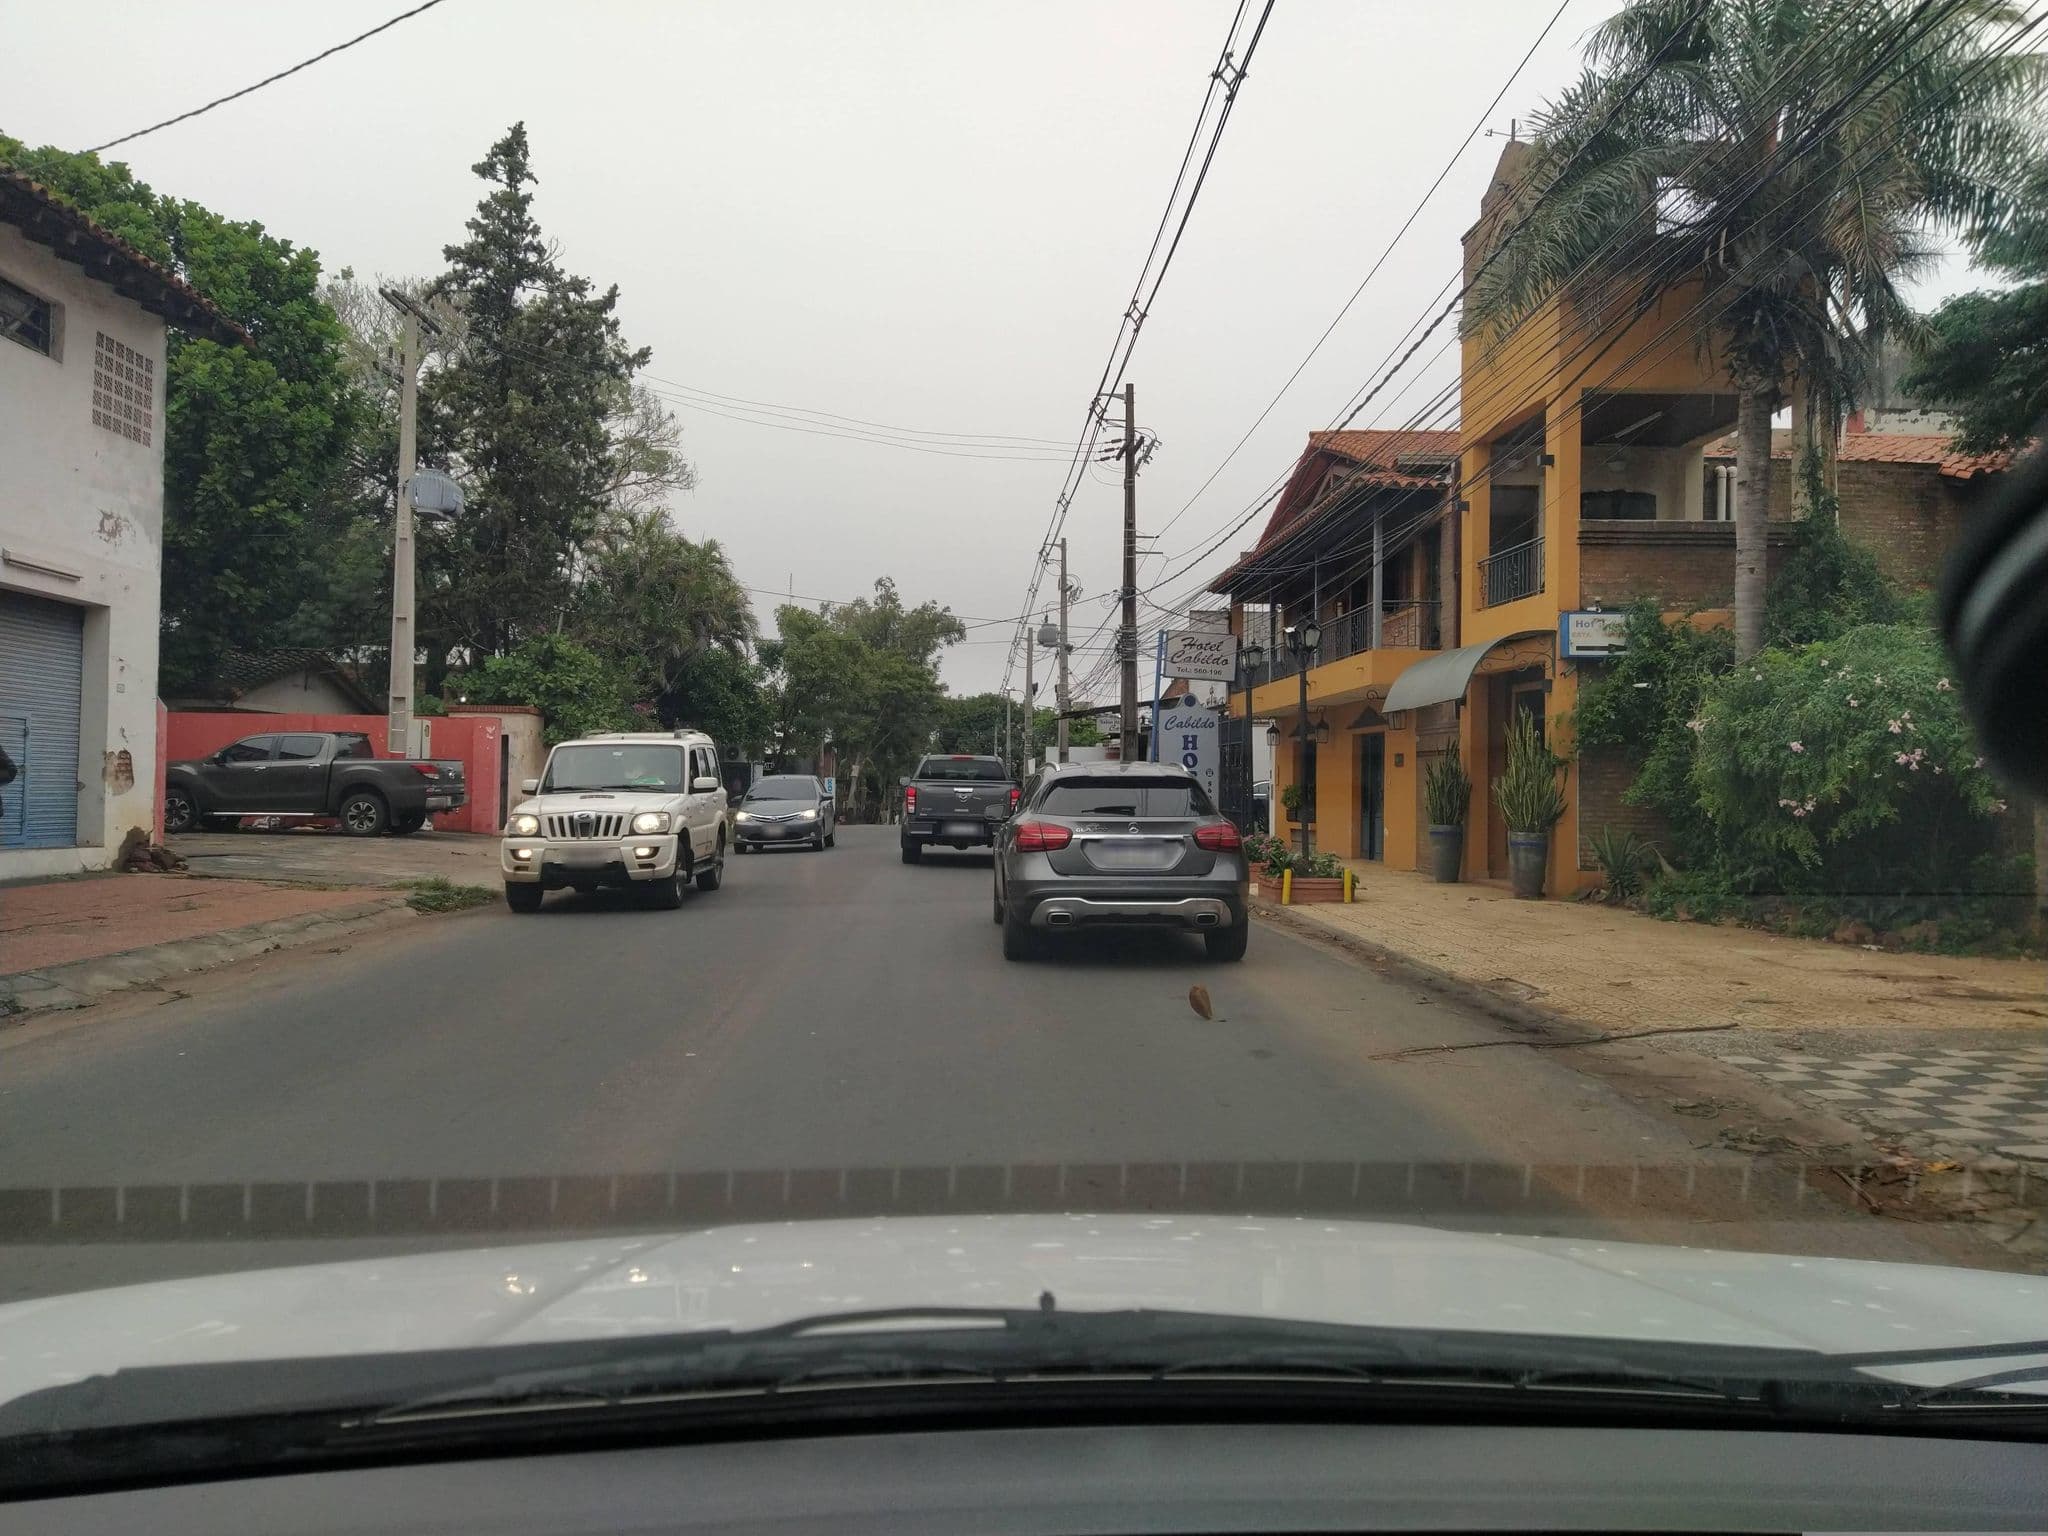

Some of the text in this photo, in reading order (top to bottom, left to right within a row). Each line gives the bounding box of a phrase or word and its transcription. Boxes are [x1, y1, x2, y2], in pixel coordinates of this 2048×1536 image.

[1180, 636, 1224, 650] Hotel
[1170, 649, 1229, 667] Cabildo
[1164, 714, 1215, 731] Cabildo
